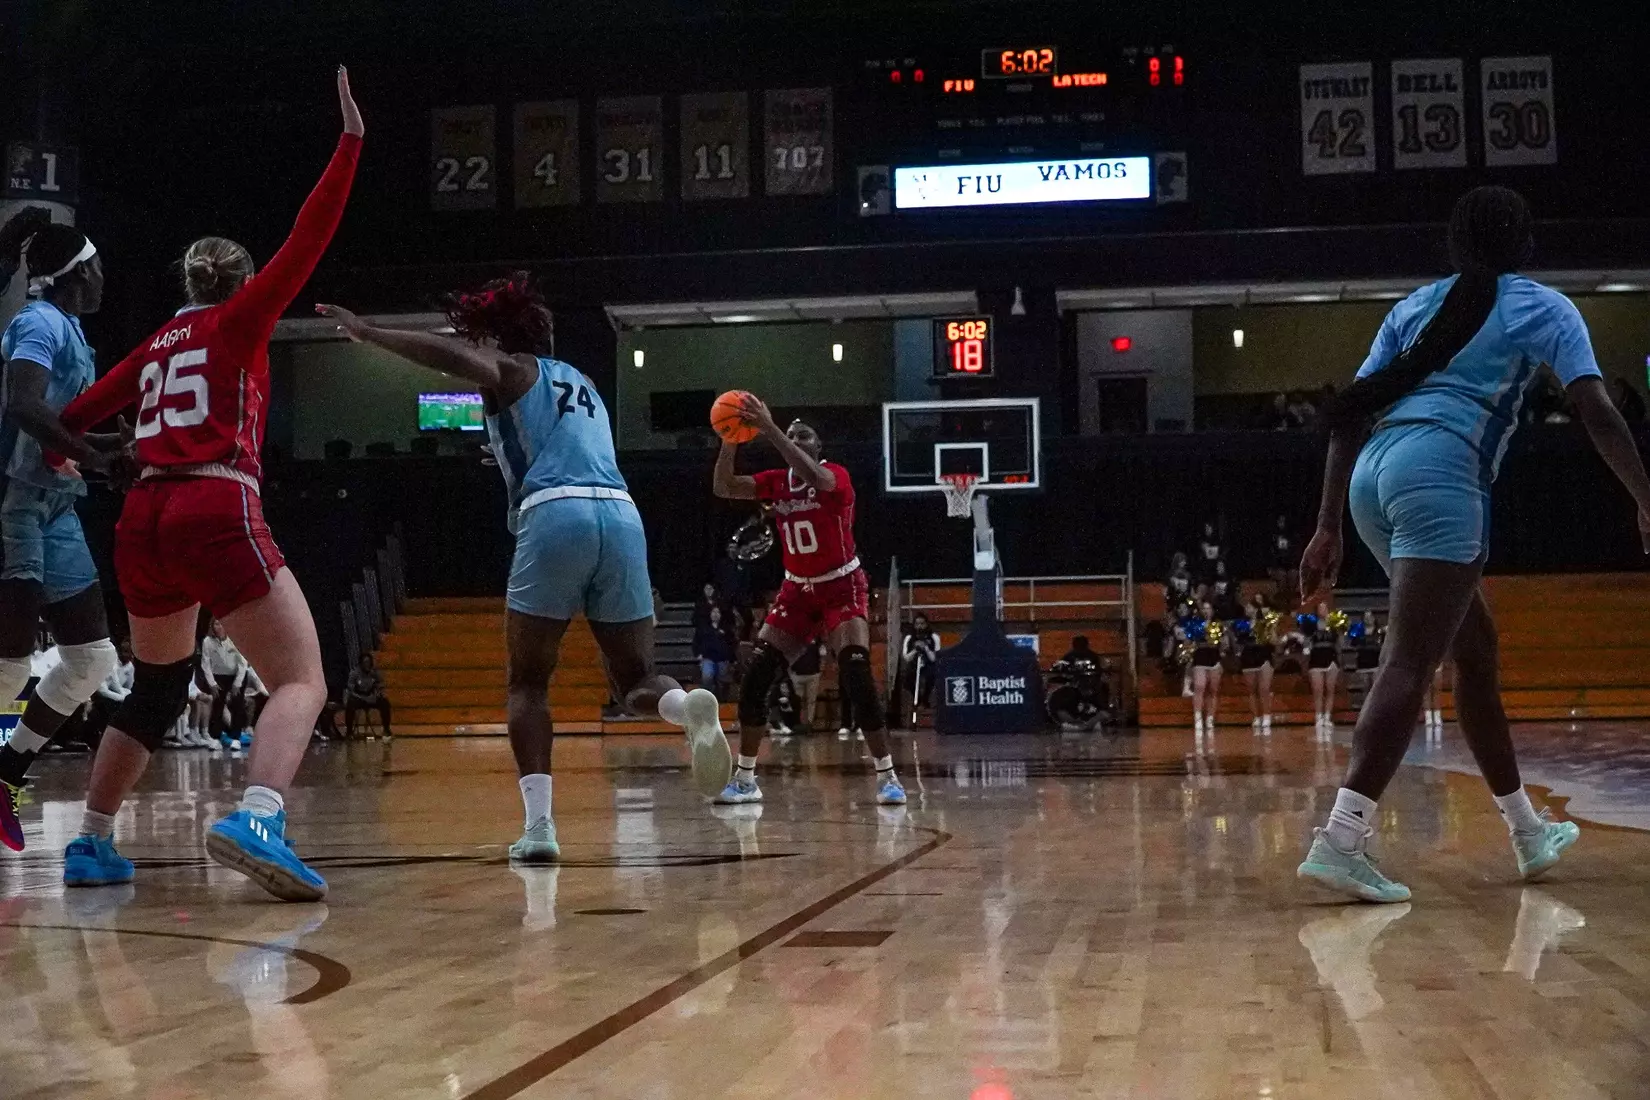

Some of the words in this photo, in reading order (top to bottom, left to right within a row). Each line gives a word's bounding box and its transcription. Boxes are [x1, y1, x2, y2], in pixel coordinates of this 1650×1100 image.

[1000, 47, 1053, 75] 6:02
[943, 79, 975, 93] FIU
[1303, 77, 1370, 99] STEWART
[1396, 73, 1457, 93] BELL
[1308, 109, 1365, 158] 42
[1398, 103, 1460, 154] 13
[1489, 101, 1549, 150] 30
[40, 152, 60, 191] 1
[436, 156, 490, 191] 22
[534, 152, 558, 186] 4
[604, 147, 652, 183] 31
[693, 145, 734, 180] 11
[957, 174, 1003, 194] FIU
[1037, 162, 1127, 181] VAMOS
[947, 320, 987, 340] 6:02
[953, 340, 983, 371] 18
[135, 348, 209, 439] 25
[551, 380, 596, 419] 24
[782, 520, 819, 555] 10
[978, 675, 1026, 692] Baptist
[978, 690, 1025, 705] Health
